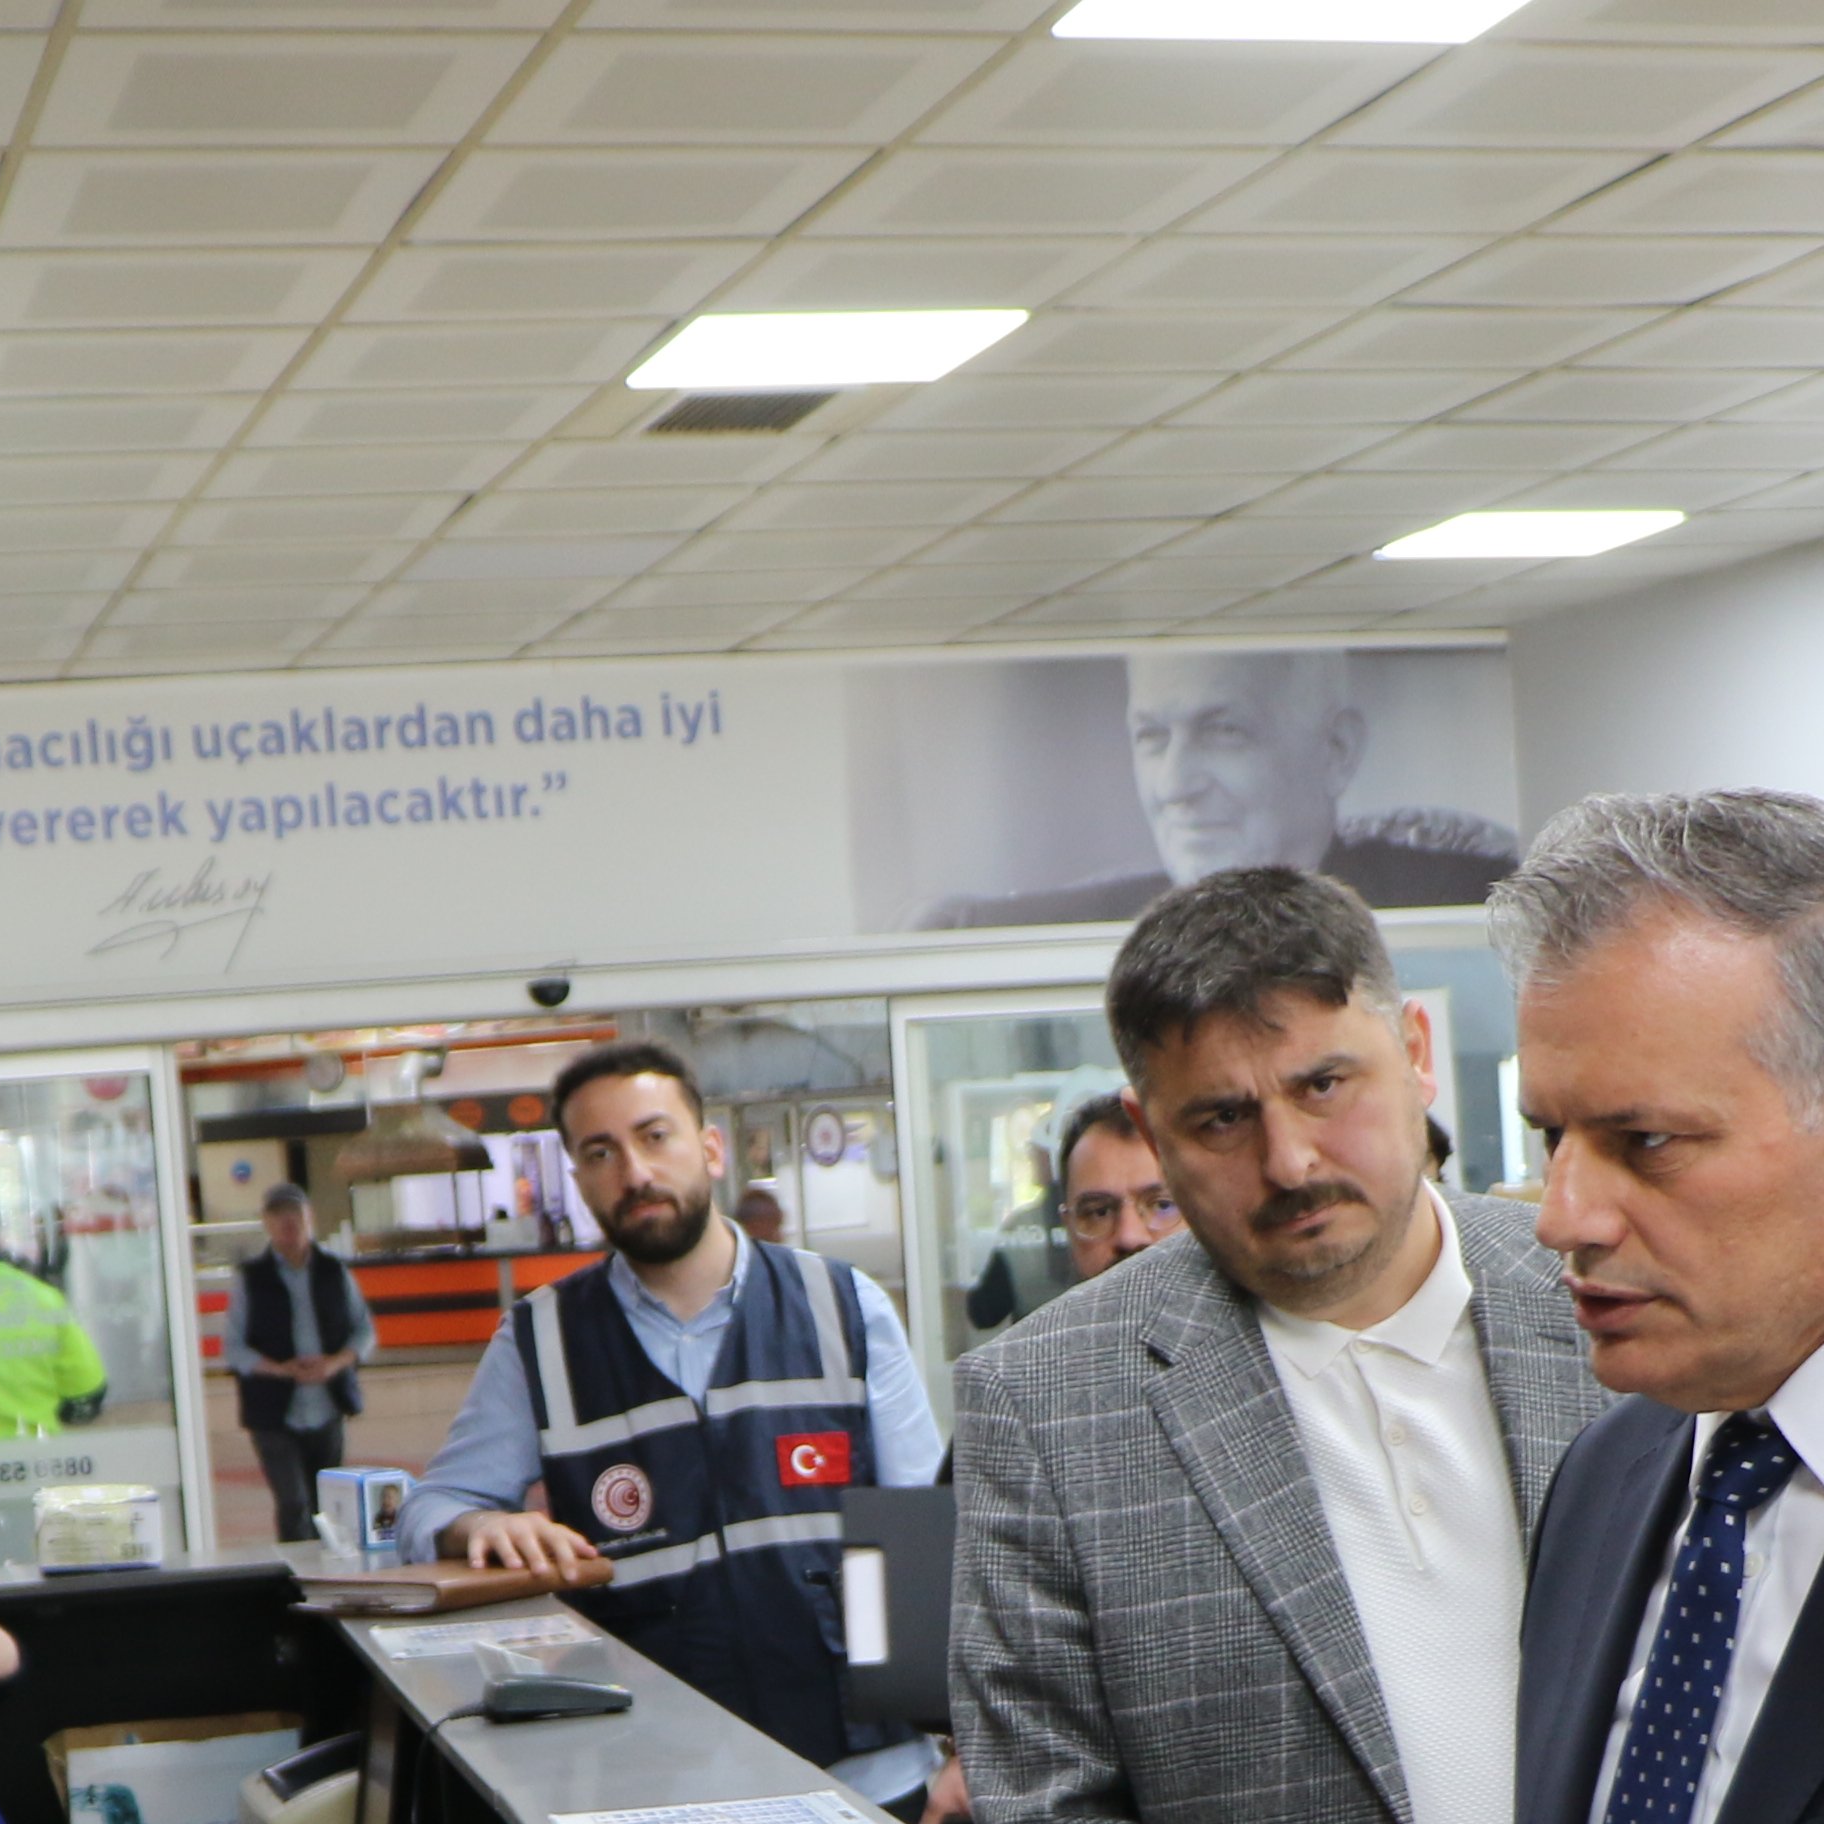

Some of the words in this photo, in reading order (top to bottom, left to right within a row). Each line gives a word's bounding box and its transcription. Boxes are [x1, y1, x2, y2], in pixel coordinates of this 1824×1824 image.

[192, 703, 496, 764] uçaklardan
[514, 694, 644, 745] daha
[659, 690, 724, 746] iyi
